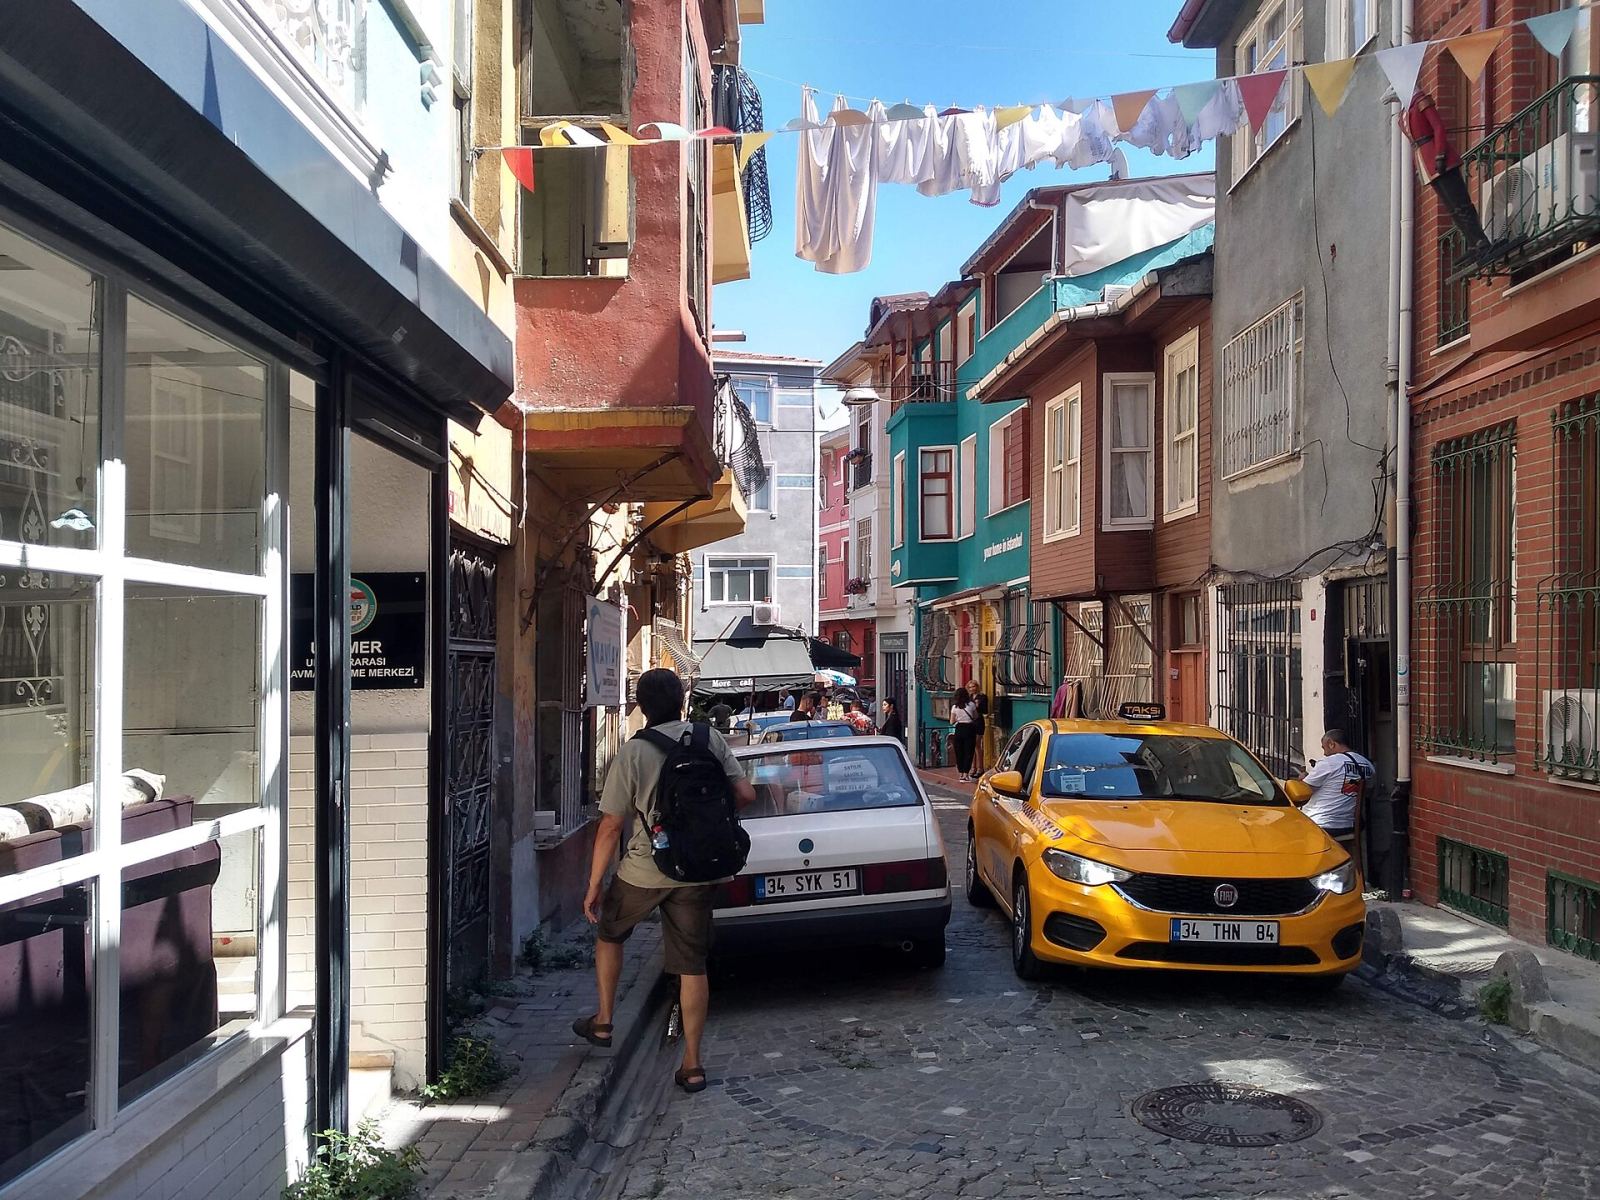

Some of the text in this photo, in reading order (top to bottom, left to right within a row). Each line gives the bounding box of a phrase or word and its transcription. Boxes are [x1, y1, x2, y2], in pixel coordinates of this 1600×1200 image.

[368, 666, 414, 677] MERKEZİ
[712, 679, 731, 688] More
[767, 878, 786, 895] 34
[795, 874, 823, 892] SYK
[832, 871, 850, 889] 51
[1219, 890, 1233, 901] FIAT
[1182, 922, 1200, 939] 34
[1213, 923, 1240, 940] THN
[1256, 924, 1274, 941] 84
